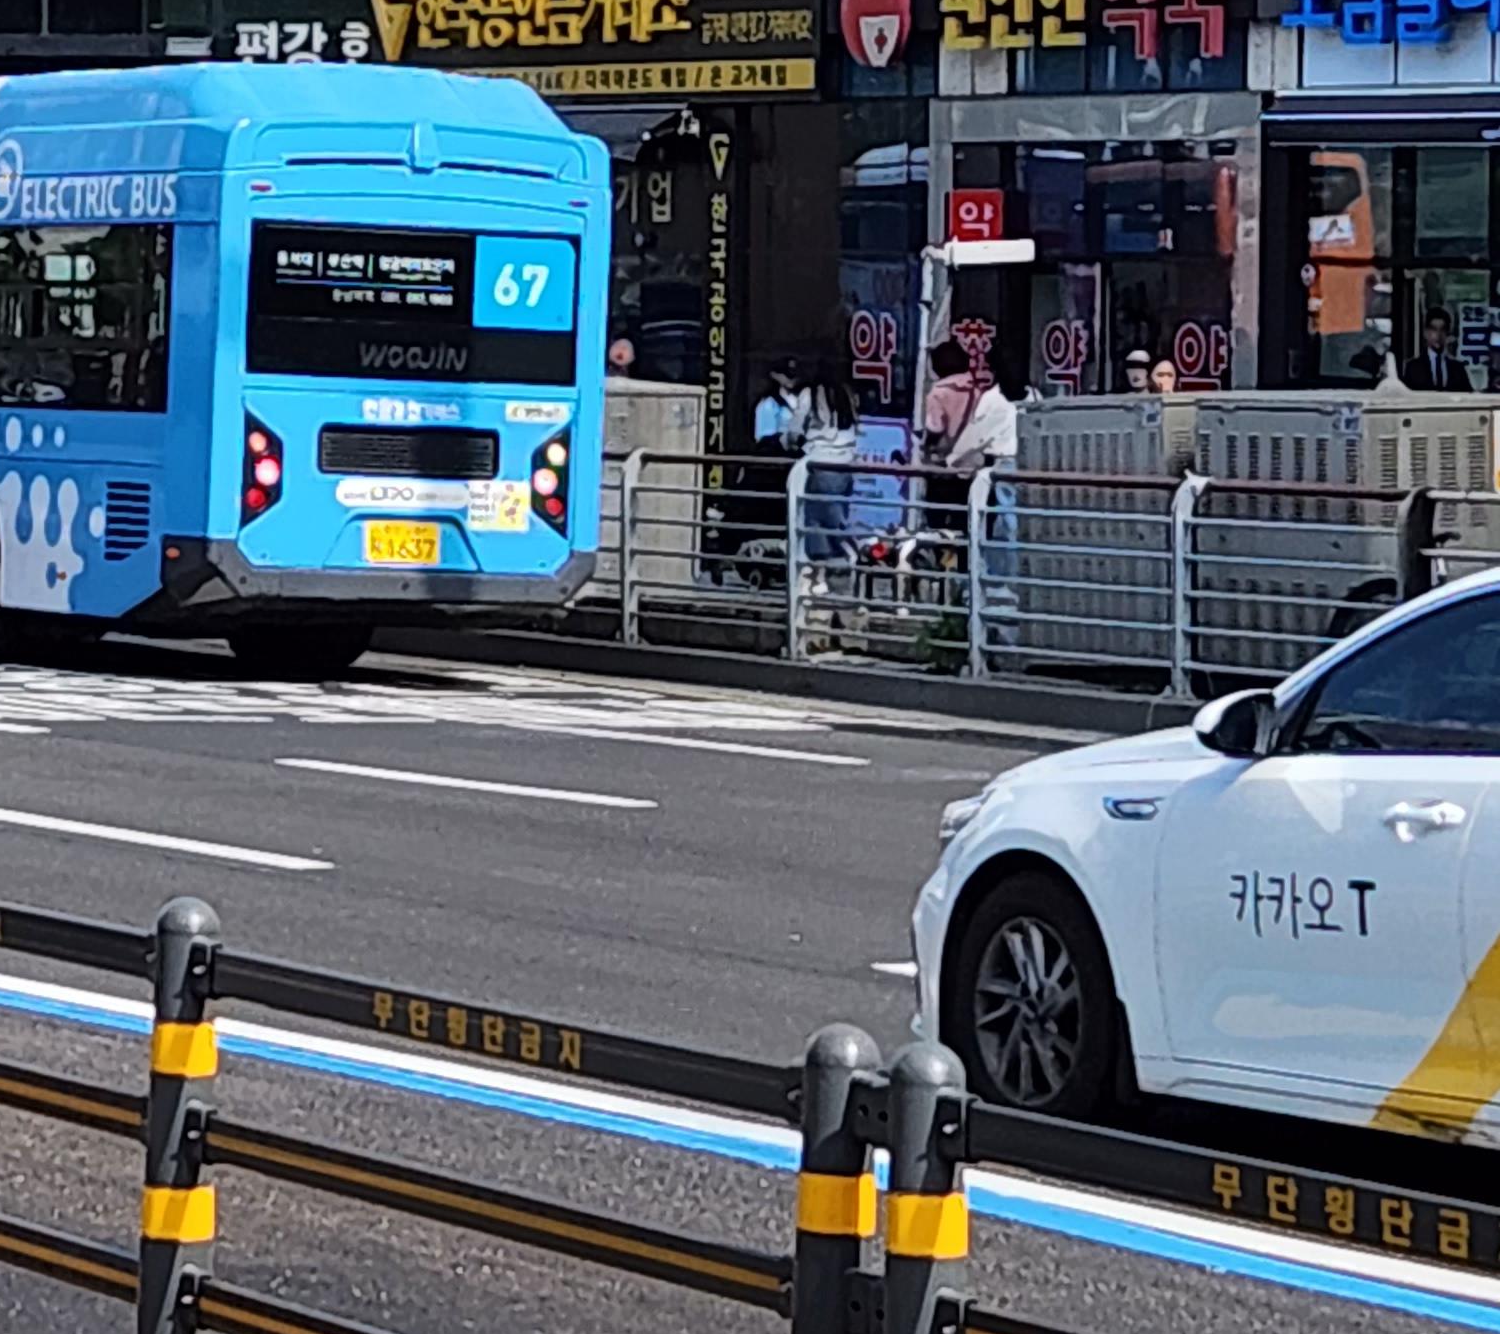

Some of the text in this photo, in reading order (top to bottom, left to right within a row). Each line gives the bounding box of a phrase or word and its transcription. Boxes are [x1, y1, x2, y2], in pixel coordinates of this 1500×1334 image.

[20, 173, 180, 218] ELECTRIC BUS
[958, 200, 995, 236] 약
[493, 262, 550, 308] 67
[357, 338, 468, 372] WOOJIN
[850, 309, 897, 404] 약
[1043, 318, 1089, 396] 약
[1229, 870, 1377, 938] 카카오T
[372, 990, 583, 1071] 무단횡단금지
